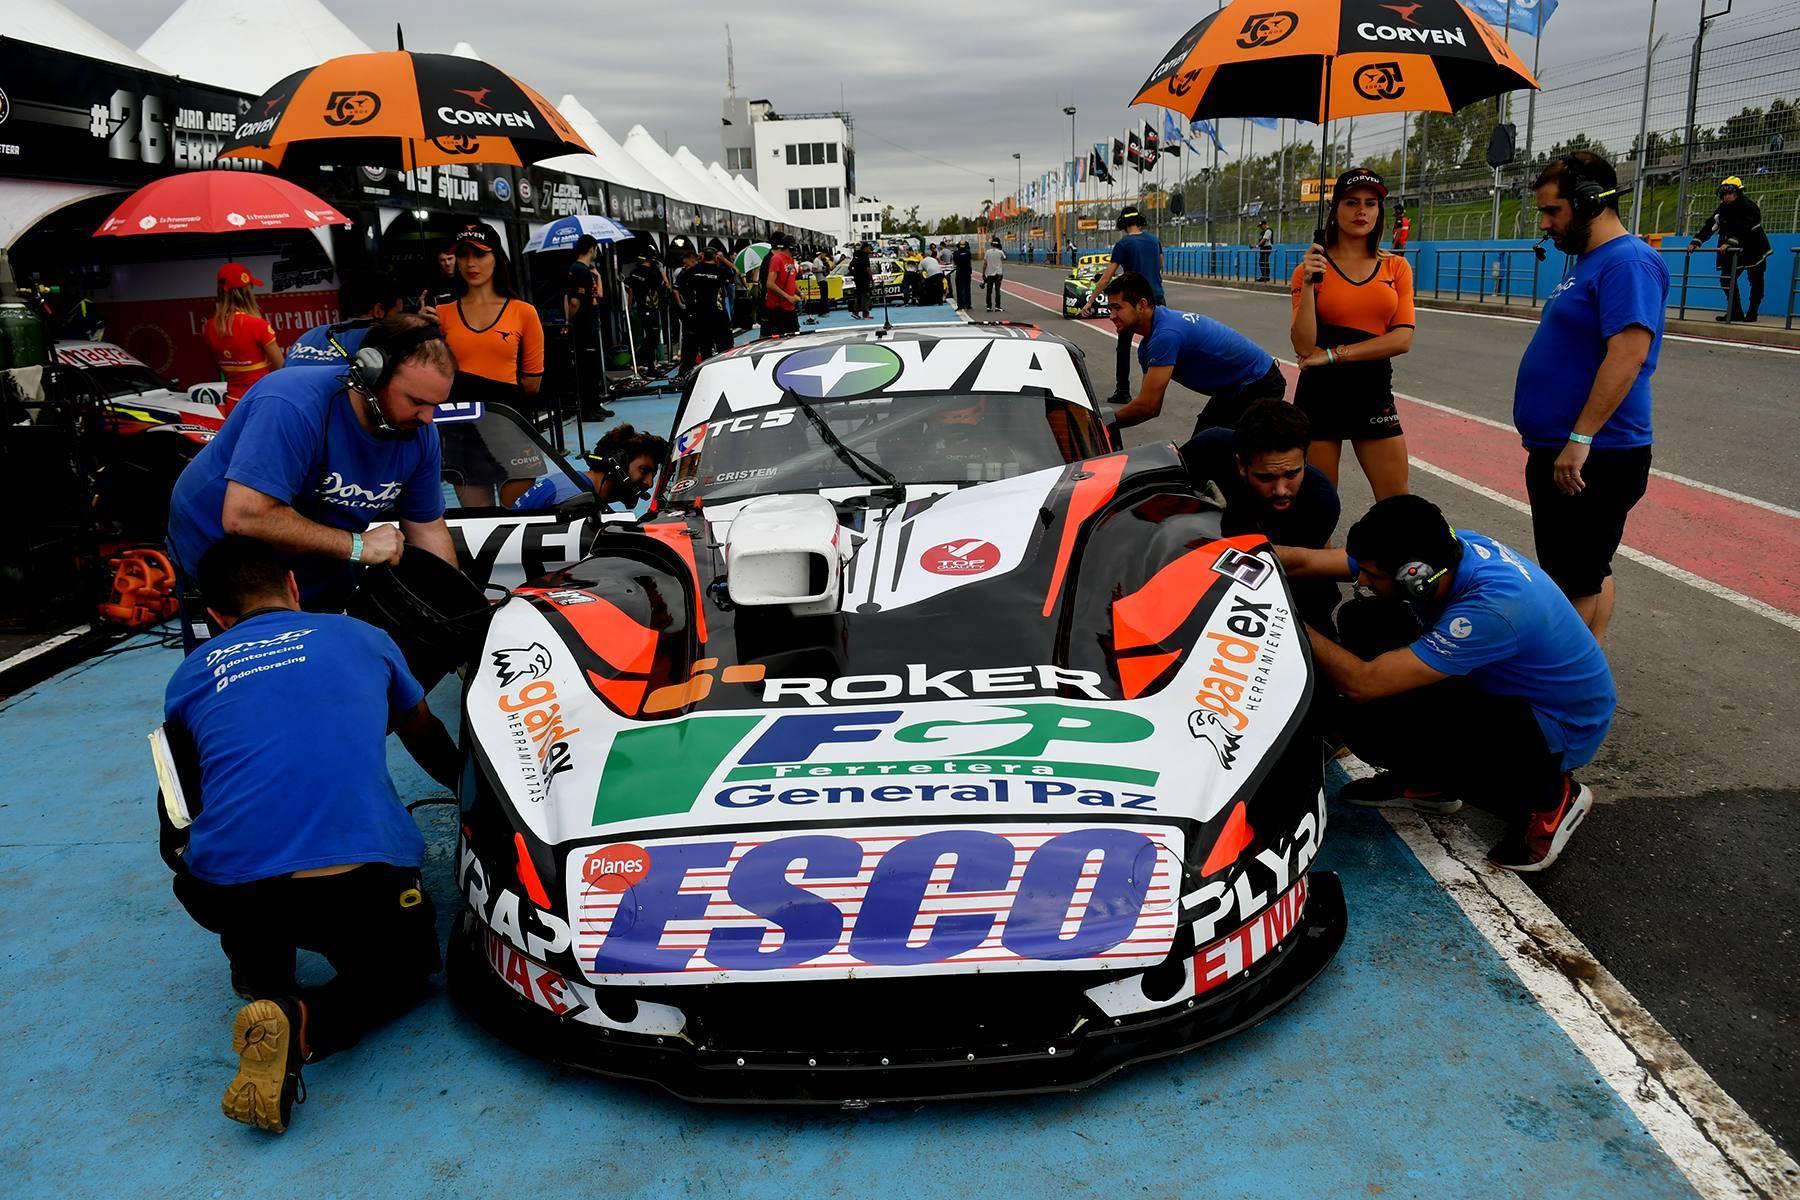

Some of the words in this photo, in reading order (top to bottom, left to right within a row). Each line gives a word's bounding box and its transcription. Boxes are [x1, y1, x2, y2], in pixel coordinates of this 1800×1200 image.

[1356, 22, 1467, 47] CORVEN
[90, 89, 166, 164] #26
[207, 113, 237, 133] JOSE
[235, 112, 281, 140] CORVEN
[437, 106, 535, 130] CORVEN
[438, 176, 479, 202] SILVA
[1347, 175, 1380, 185] CORVEN
[675, 338, 1093, 438] NOVA
[707, 413, 757, 438] TC
[760, 408, 797, 430] 5
[716, 467, 777, 482] CRISTEM
[938, 558, 986, 568] TOP
[226, 644, 304, 668] dontoracing
[229, 655, 306, 683] @dontoracing
[1195, 595, 1272, 732] gardex
[1246, 607, 1289, 711] HERRAMIENTAS
[762, 663, 1111, 706] ROKER
[737, 704, 1156, 765] FGP
[507, 714, 545, 803] HERRAMIENTAS
[771, 763, 1054, 778] Ferretera
[714, 779, 1010, 809] General
[1025, 780, 1158, 812] Paz
[589, 854, 644, 876] Planes
[594, 828, 1158, 972] ESCO
